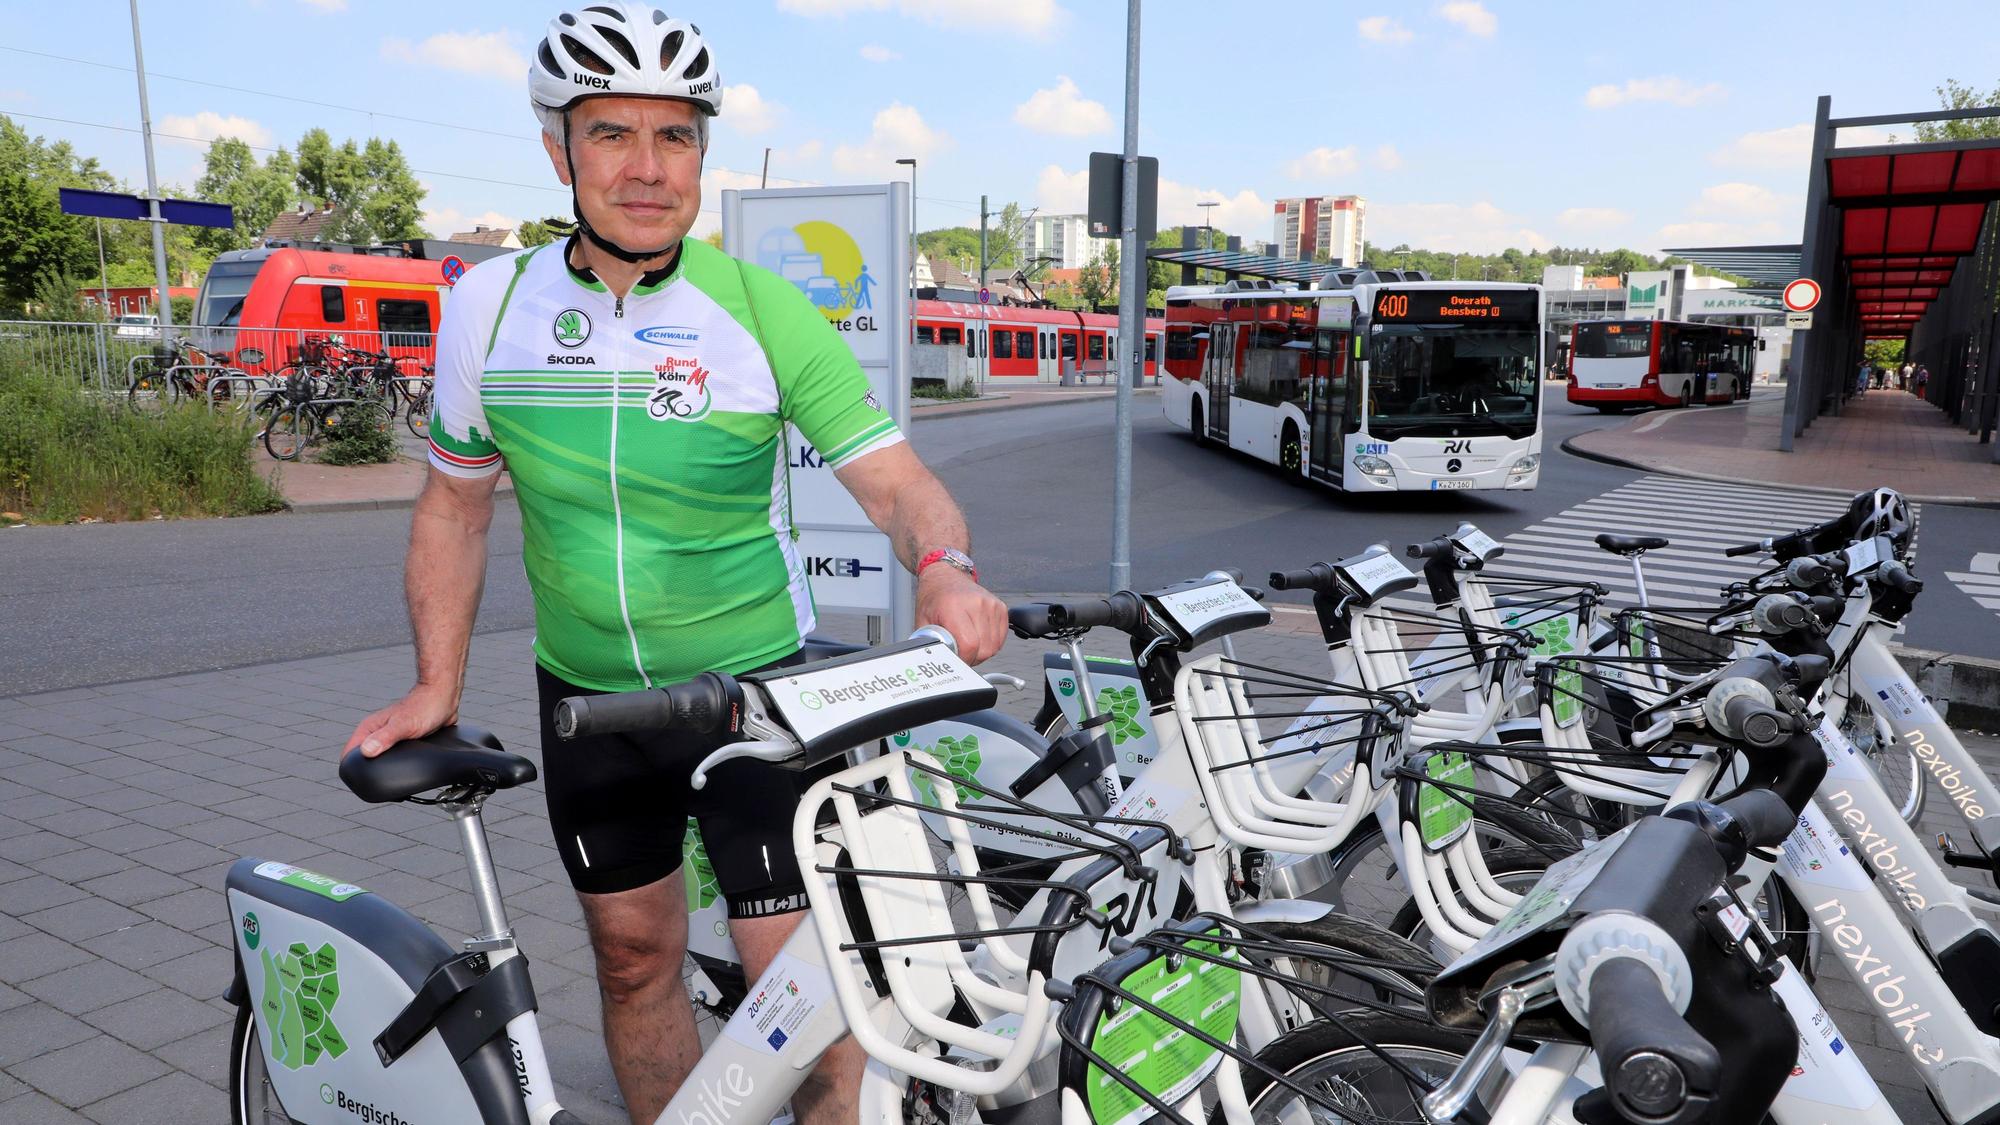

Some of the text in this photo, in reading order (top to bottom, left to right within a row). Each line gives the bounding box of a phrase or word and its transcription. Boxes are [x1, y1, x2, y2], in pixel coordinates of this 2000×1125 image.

[574, 73, 611, 91] uvex
[689, 81, 713, 95] uvex
[1378, 295, 1491, 317] 400 Overath
[1440, 307, 1487, 316] Bensberg
[1704, 300, 1783, 309] MARKTKA
[856, 316, 878, 331] GL
[645, 331, 699, 341] SCHWALBE
[547, 354, 596, 365] ŠKODA
[666, 356, 697, 368] Rund
[655, 364, 674, 372] um
[659, 371, 686, 382] Köln
[818, 673, 908, 704] Bergisches
[905, 662, 954, 682] e-Bike
[1058, 680, 1072, 689] VRS
[1904, 729, 1985, 820] nextbike
[1829, 790, 1926, 911] nextbike
[242, 916, 257, 933] VRS
[1814, 899, 1944, 1065] nextbike
[337, 1089, 415, 1125] Bergisch
